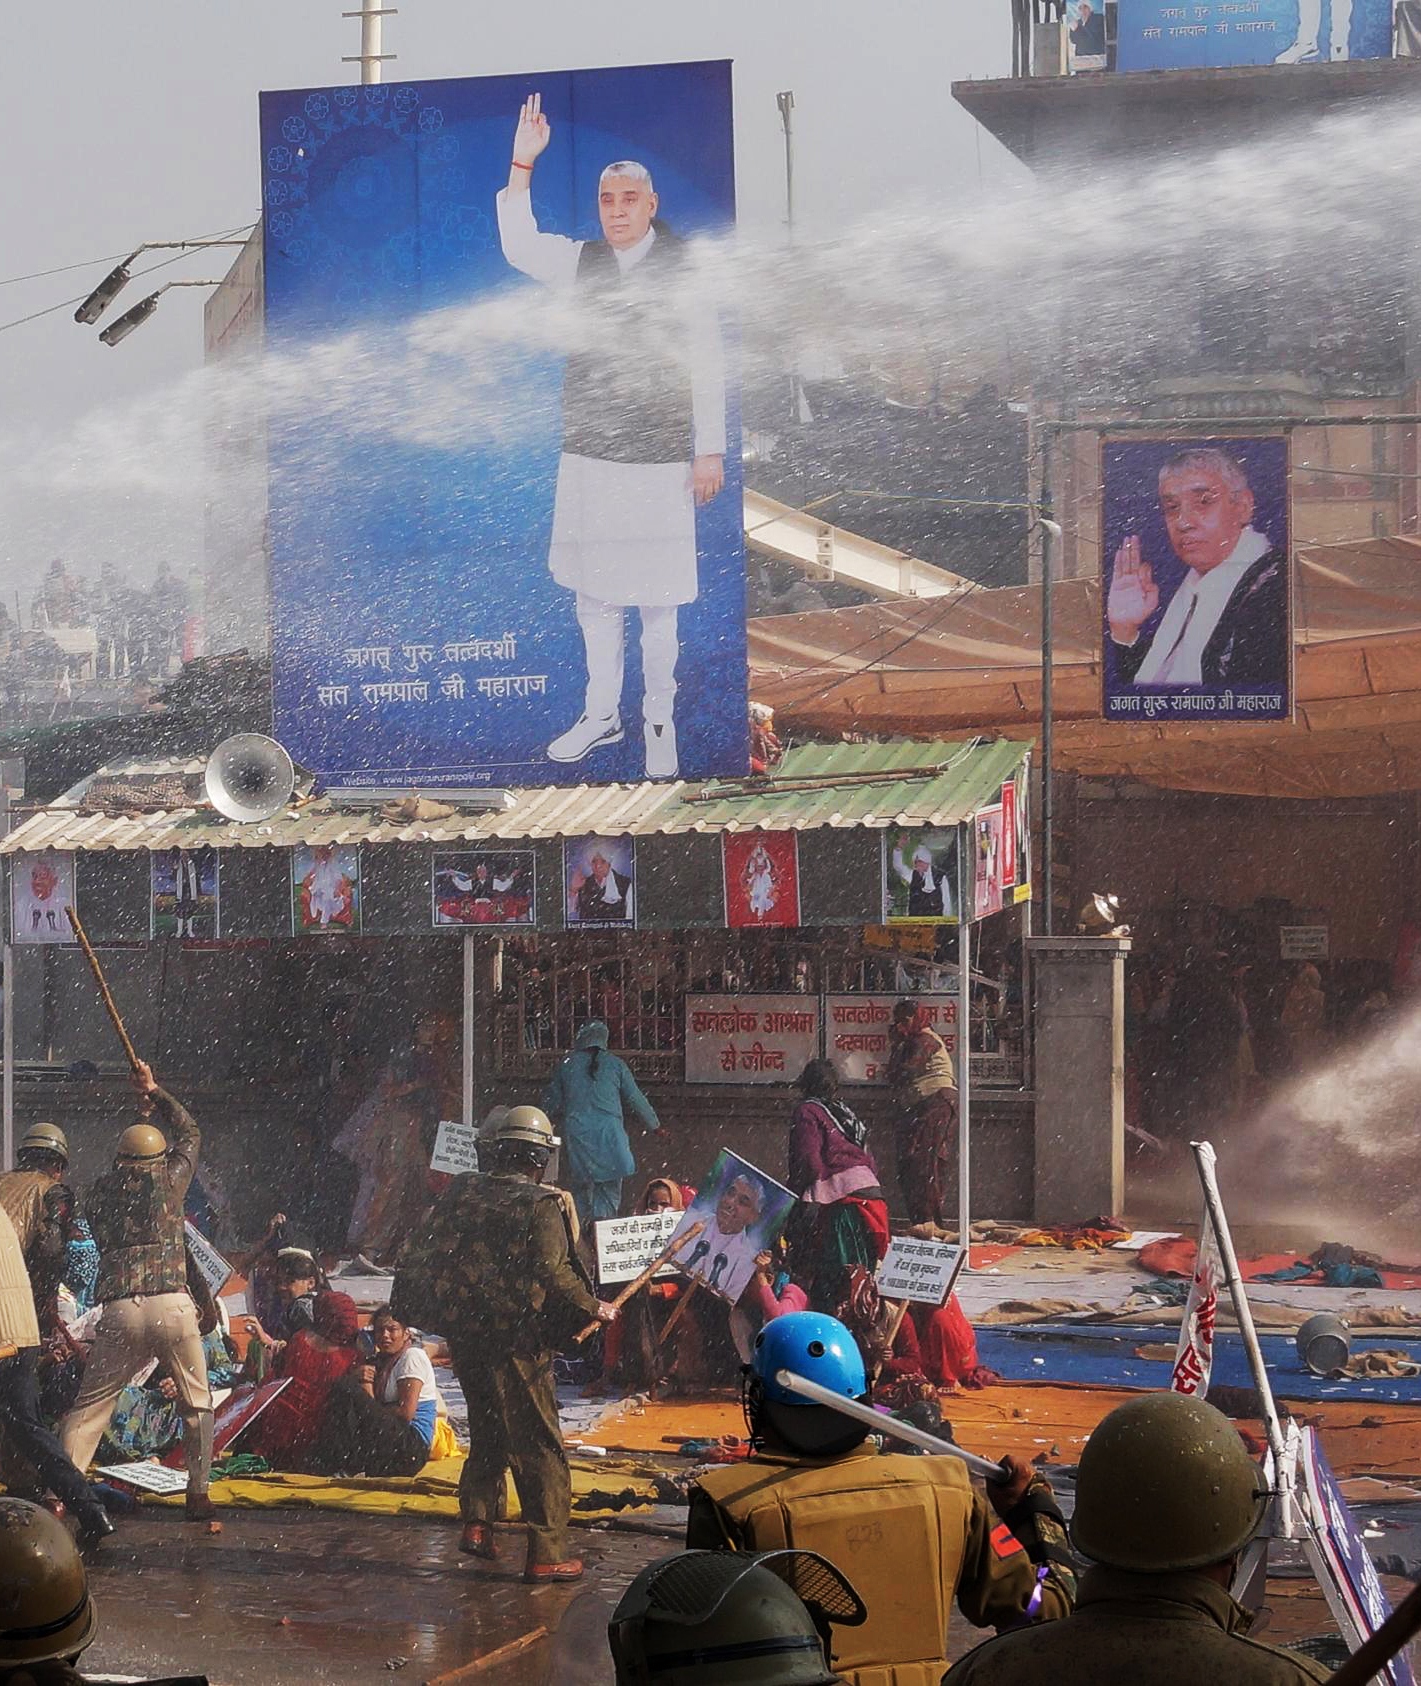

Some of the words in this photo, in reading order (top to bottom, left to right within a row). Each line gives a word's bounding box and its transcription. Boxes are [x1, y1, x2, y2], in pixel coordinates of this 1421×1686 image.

[1142, 26, 1161, 39] संत
[1168, 24, 1208, 38] रामपाल
[1214, 20, 1229, 35] जी
[402, 644, 434, 672] गुरु
[362, 680, 430, 703] रामपाल
[441, 673, 466, 699] जी
[476, 674, 548, 697] महाराज
[1110, 695, 1140, 711] जगत
[1171, 695, 1216, 711] रामपाल
[1218, 690, 1234, 711] जी
[1237, 695, 1282, 711] महाराज
[692, 1005, 759, 1033] सतलोक
[763, 1010, 814, 1033] आश्रम
[833, 1000, 891, 1024] सतलोक
[943, 1001, 958, 1024] से
[720, 1043, 736, 1071] से
[741, 1041, 786, 1071] जीन्द
